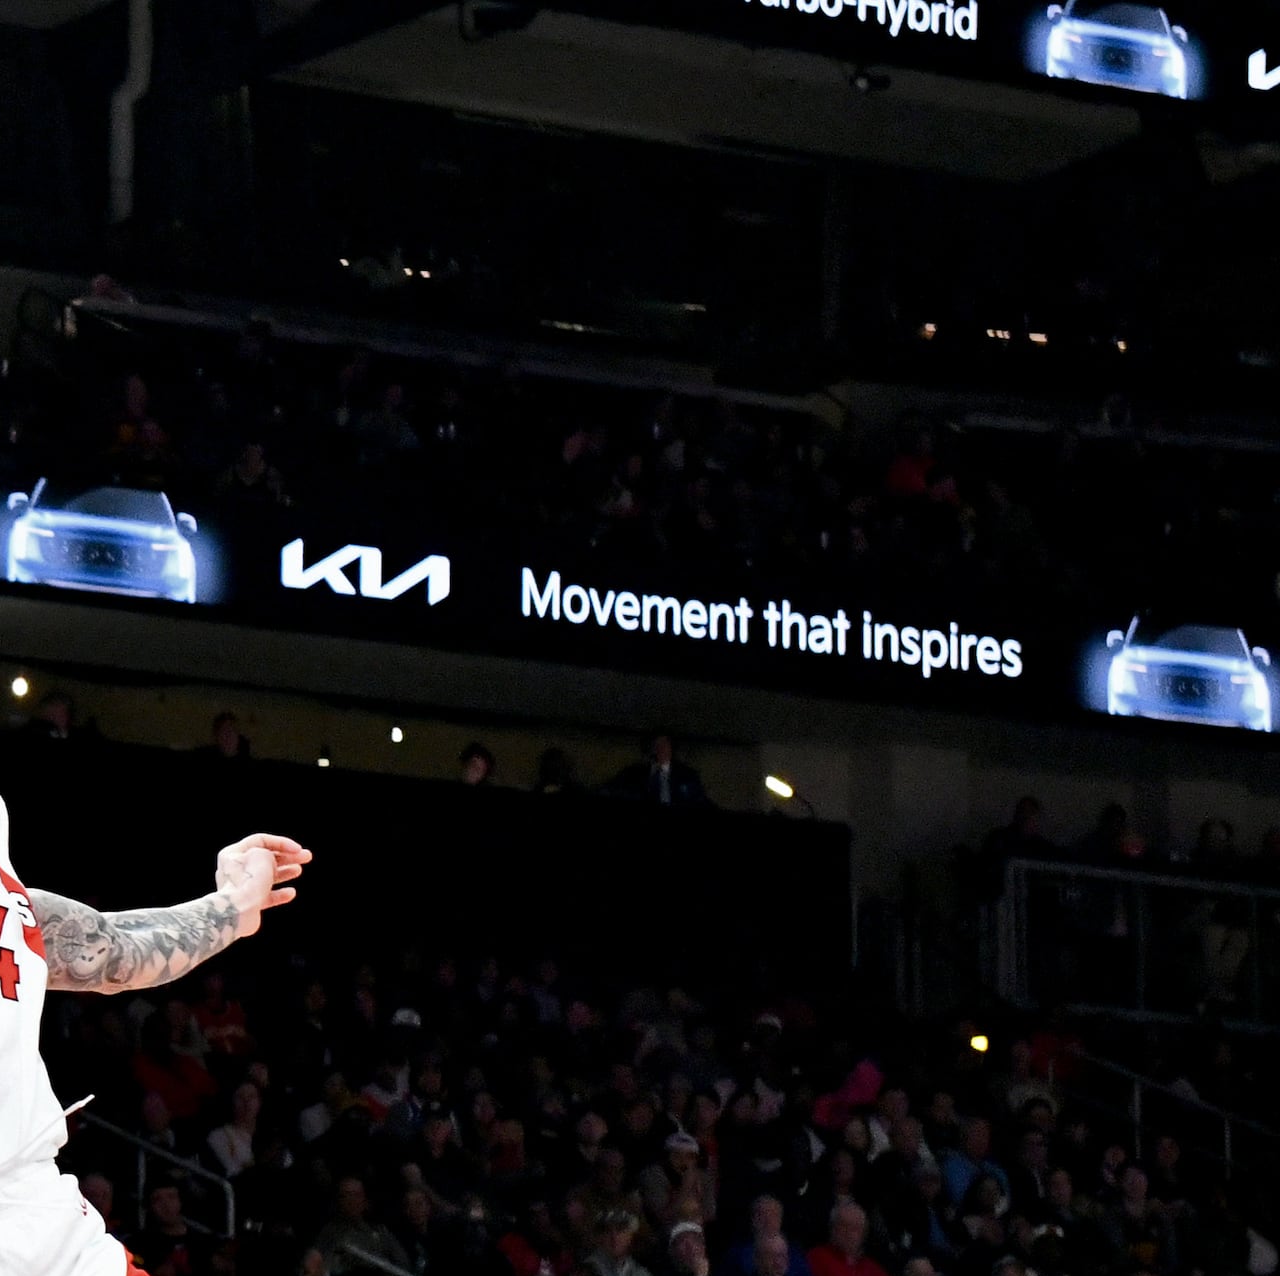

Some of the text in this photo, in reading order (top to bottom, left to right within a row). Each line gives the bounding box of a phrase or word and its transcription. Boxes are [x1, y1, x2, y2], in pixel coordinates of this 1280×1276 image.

[744, 0, 978, 41] o-Hybrid
[522, 568, 1023, 680] Movement that inspires
